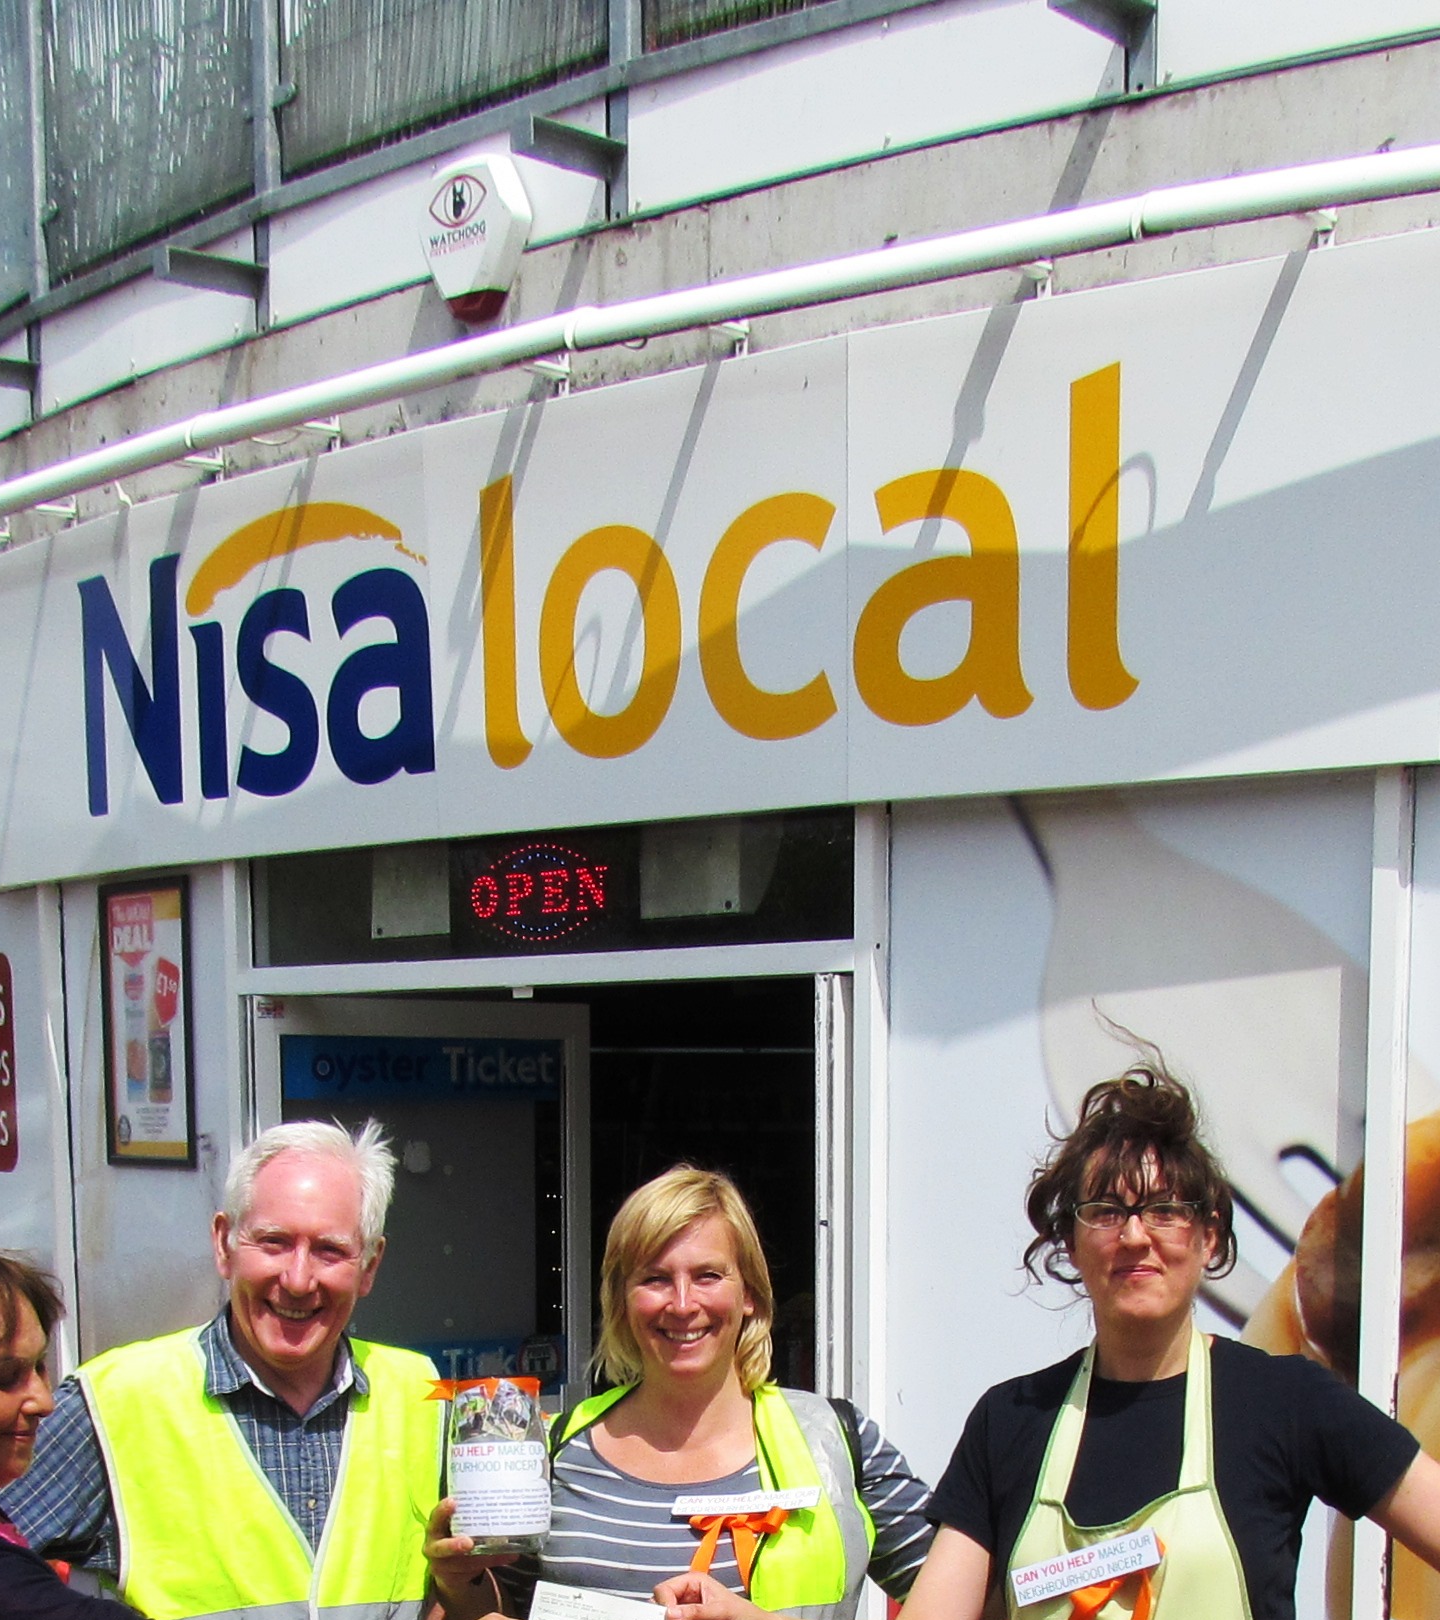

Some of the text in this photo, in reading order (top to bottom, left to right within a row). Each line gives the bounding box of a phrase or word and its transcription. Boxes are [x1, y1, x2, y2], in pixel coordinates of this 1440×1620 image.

[429, 219, 486, 250] WATCHDOG
[77, 361, 1140, 818] Nisa local
[471, 865, 609, 919] OPEN
[113, 923, 154, 953] DEAL
[311, 1046, 555, 1093] oyster Ticket
[466, 1445, 495, 1457] HELP
[497, 1444, 527, 1456] MAKE
[504, 1459, 538, 1472] NICER?
[679, 1489, 816, 1505] CAN YOU HELP MAKE OUR
[1015, 1534, 1152, 1586] CAN YOU HELP MAKE OUR
[1018, 1553, 1144, 1601] NEIGHBOURHOOD NICER?
